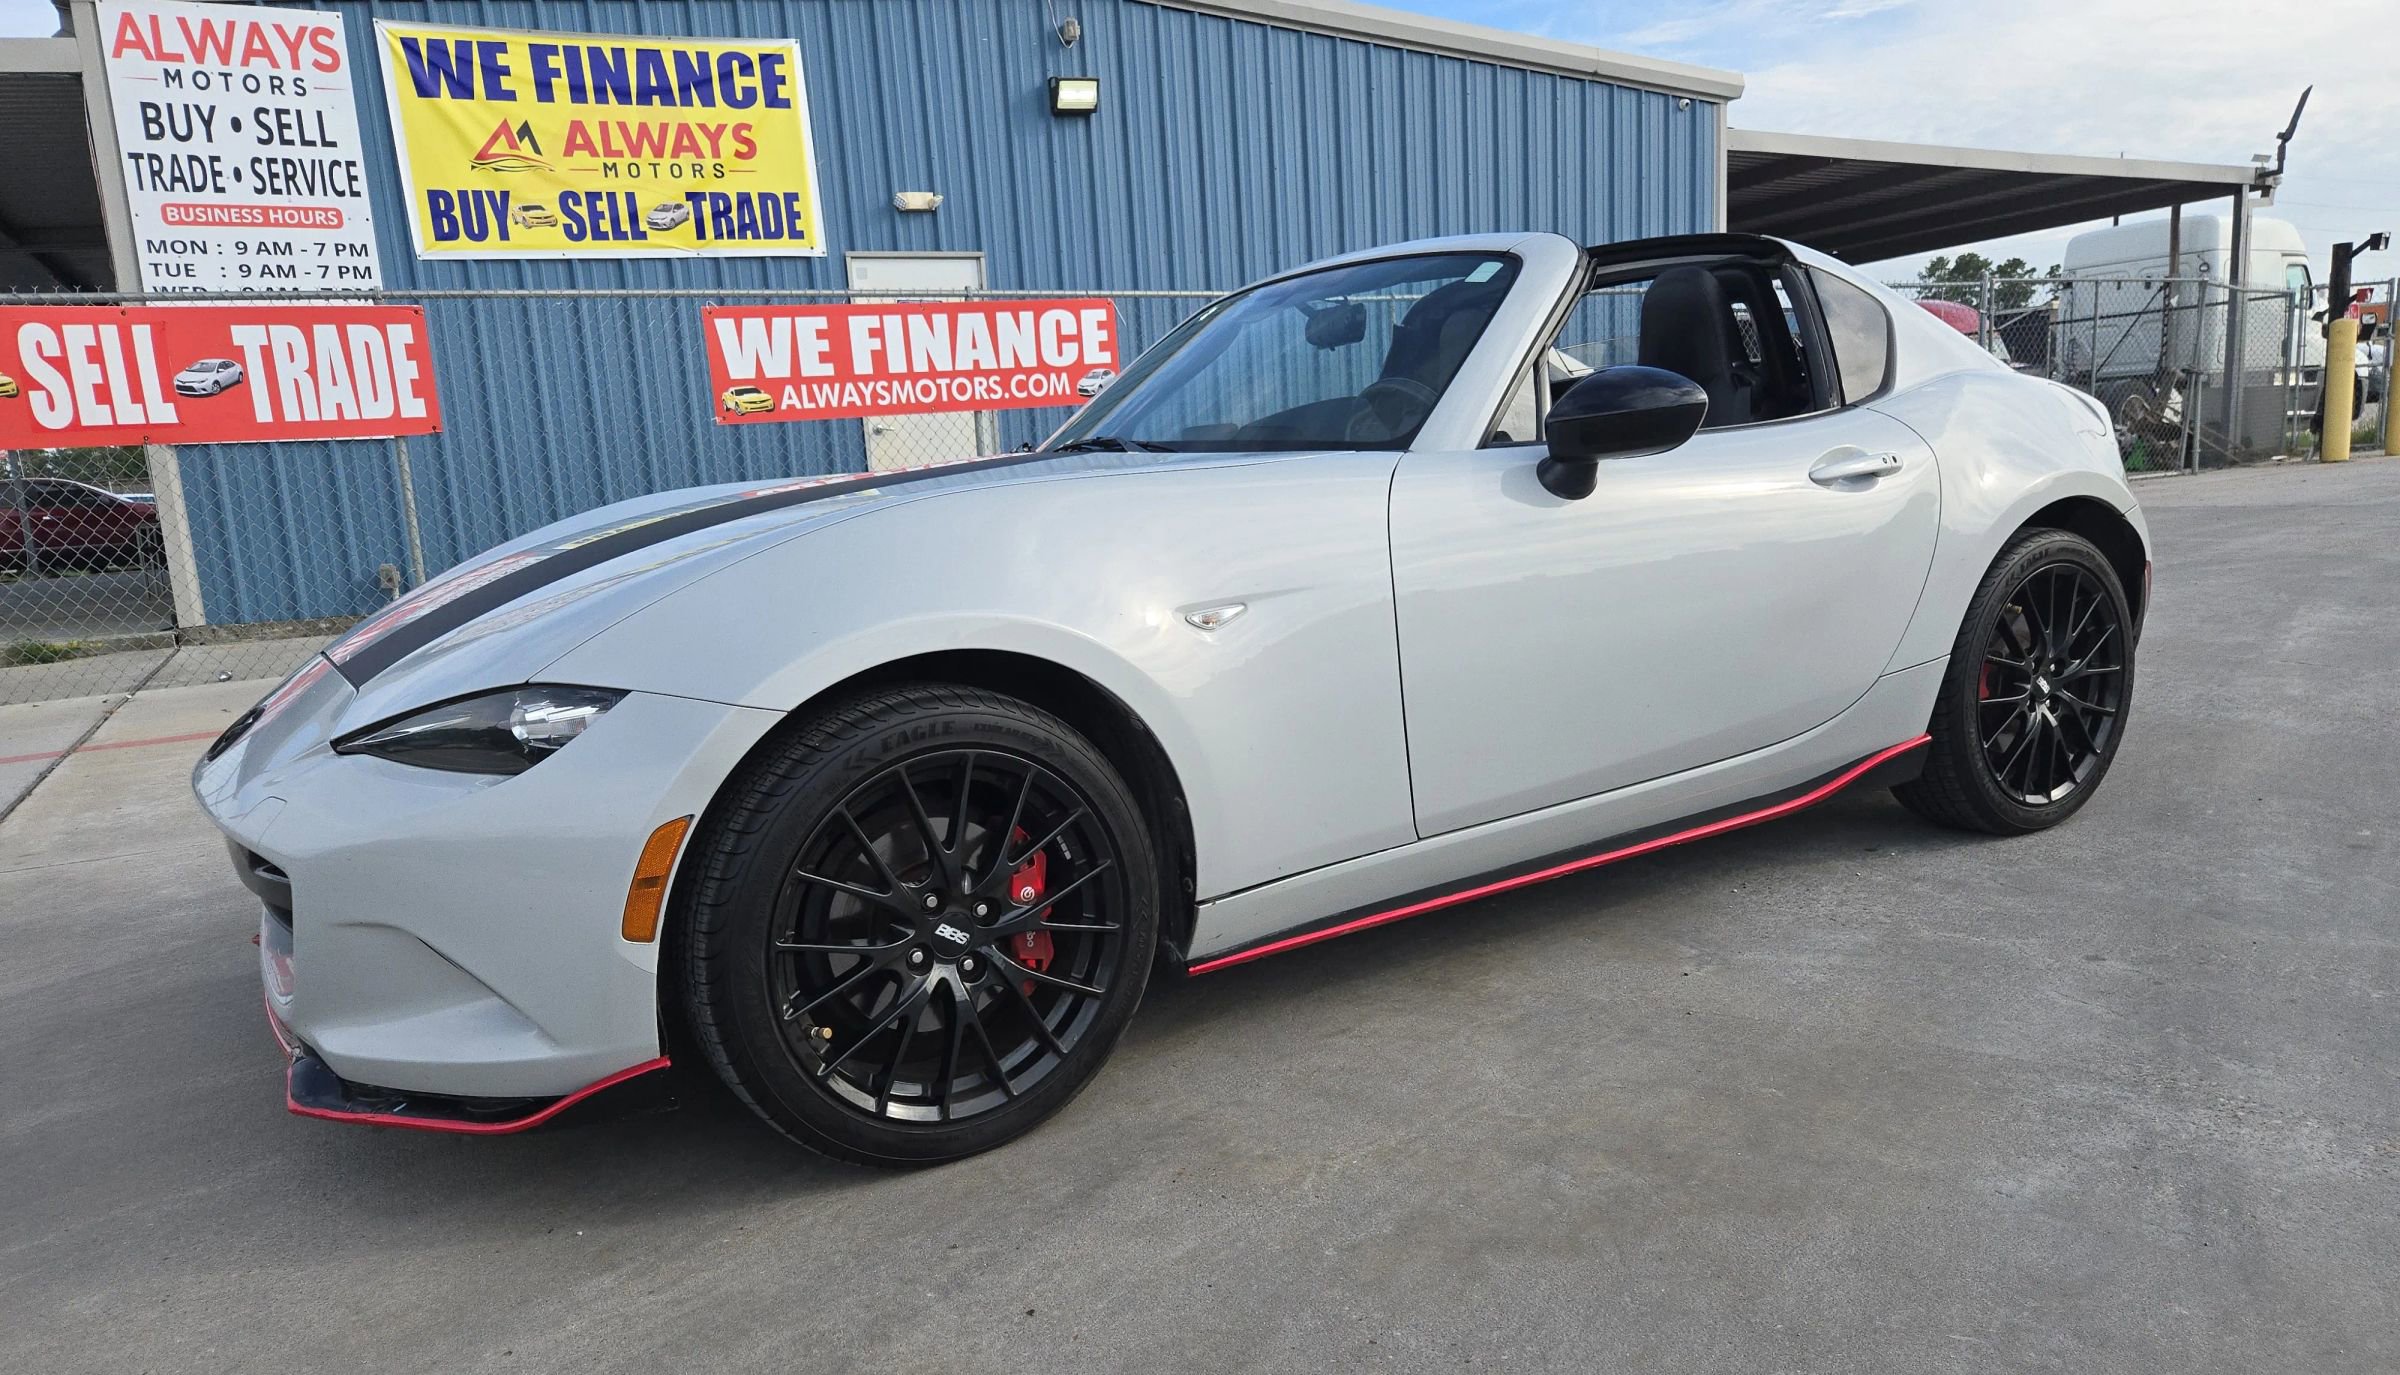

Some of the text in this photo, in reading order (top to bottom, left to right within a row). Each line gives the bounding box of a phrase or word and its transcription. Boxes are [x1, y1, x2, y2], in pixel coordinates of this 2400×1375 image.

[112, 12, 340, 73] ALWAYS
[163, 68, 307, 97] MOTORS
[401, 37, 792, 109] WE FINANCE
[140, 102, 338, 148] BUY SELL
[563, 119, 758, 161] ALWAYS
[128, 152, 362, 198] TRADE SERVICE
[603, 162, 725, 179] MOTORS
[166, 206, 340, 227] BUSINESS HOURS
[427, 189, 806, 242] BUY SELL TRADE
[146, 239, 208, 256] MON
[334, 242, 369, 258] PM
[148, 262, 197, 278] TUE
[338, 265, 373, 280] PM
[714, 309, 1111, 380] WE FINANCE
[18, 322, 427, 430] SELL TRADE
[780, 372, 1071, 410] ALWAYSMOTORS.COM
[934, 923, 970, 945] BBS
